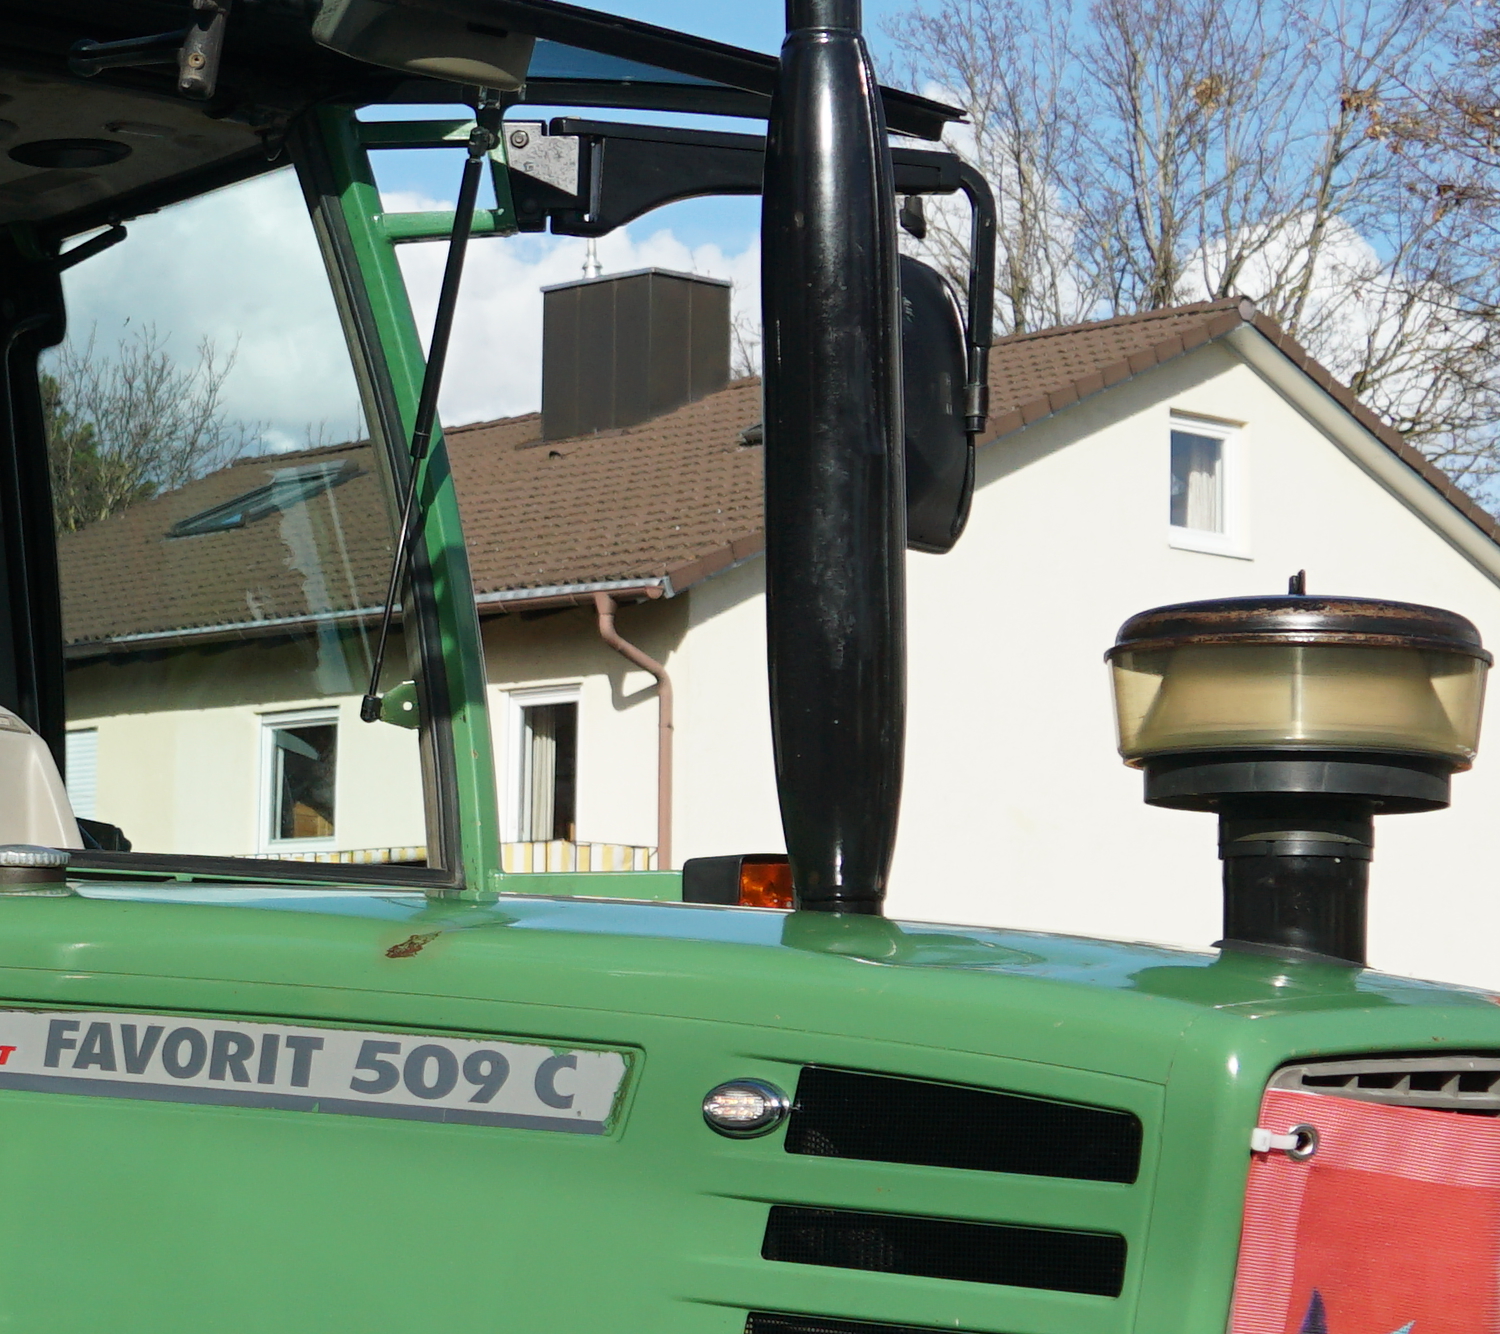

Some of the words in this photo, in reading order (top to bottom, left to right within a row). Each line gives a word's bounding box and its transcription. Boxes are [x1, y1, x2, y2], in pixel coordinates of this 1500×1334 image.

[44, 1019, 325, 1090] FAVORIT
[350, 1040, 513, 1105] 509
[534, 1054, 578, 1109] C
